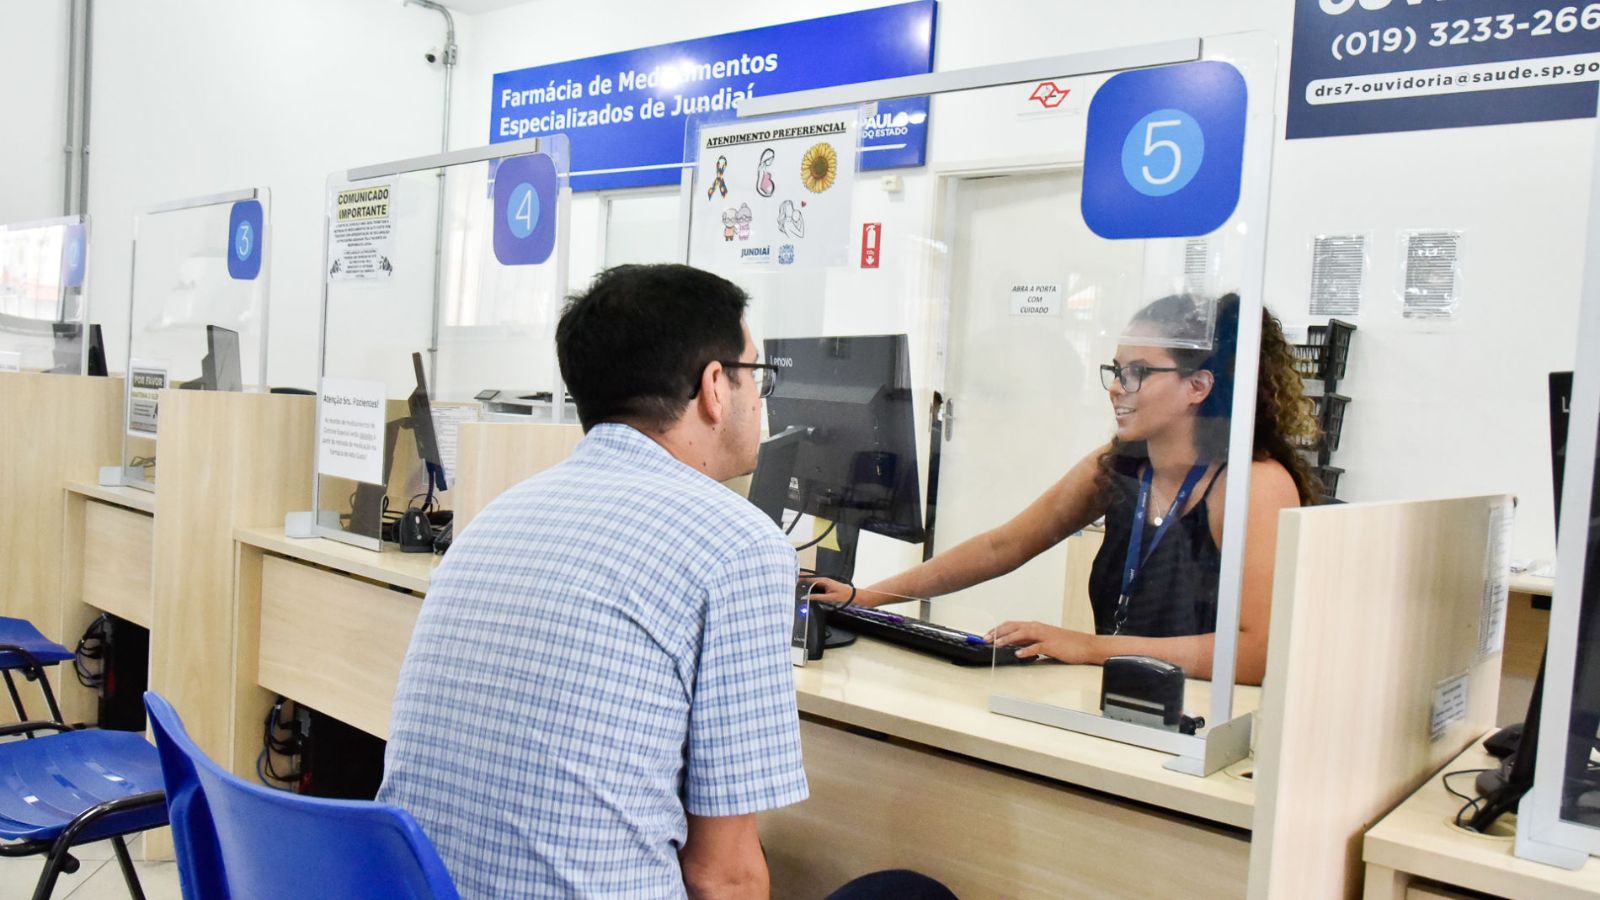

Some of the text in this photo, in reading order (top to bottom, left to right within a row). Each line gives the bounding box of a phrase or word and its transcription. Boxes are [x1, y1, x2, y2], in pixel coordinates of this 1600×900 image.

[1332, 25, 1417, 61] (019)
[501, 80, 583, 108] Farmácia
[588, 75, 612, 97] de
[1314, 60, 1600, 98] drs7-ouvidoria@saude.sp.go
[499, 103, 634, 138] Especializados
[640, 96, 665, 120] de
[875, 127, 908, 138] ESTADO
[706, 121, 846, 147] ATENDIMENTO PREFERENCIAL
[1141, 119, 1182, 185] 5
[338, 189, 388, 205] COMUNICADO
[338, 204, 387, 220] IMPORTANTE
[514, 188, 532, 231] 4
[239, 225, 249, 256] 3
[741, 244, 770, 258] JUNDIAÍ
[1020, 306, 1049, 314] CUIDADO
